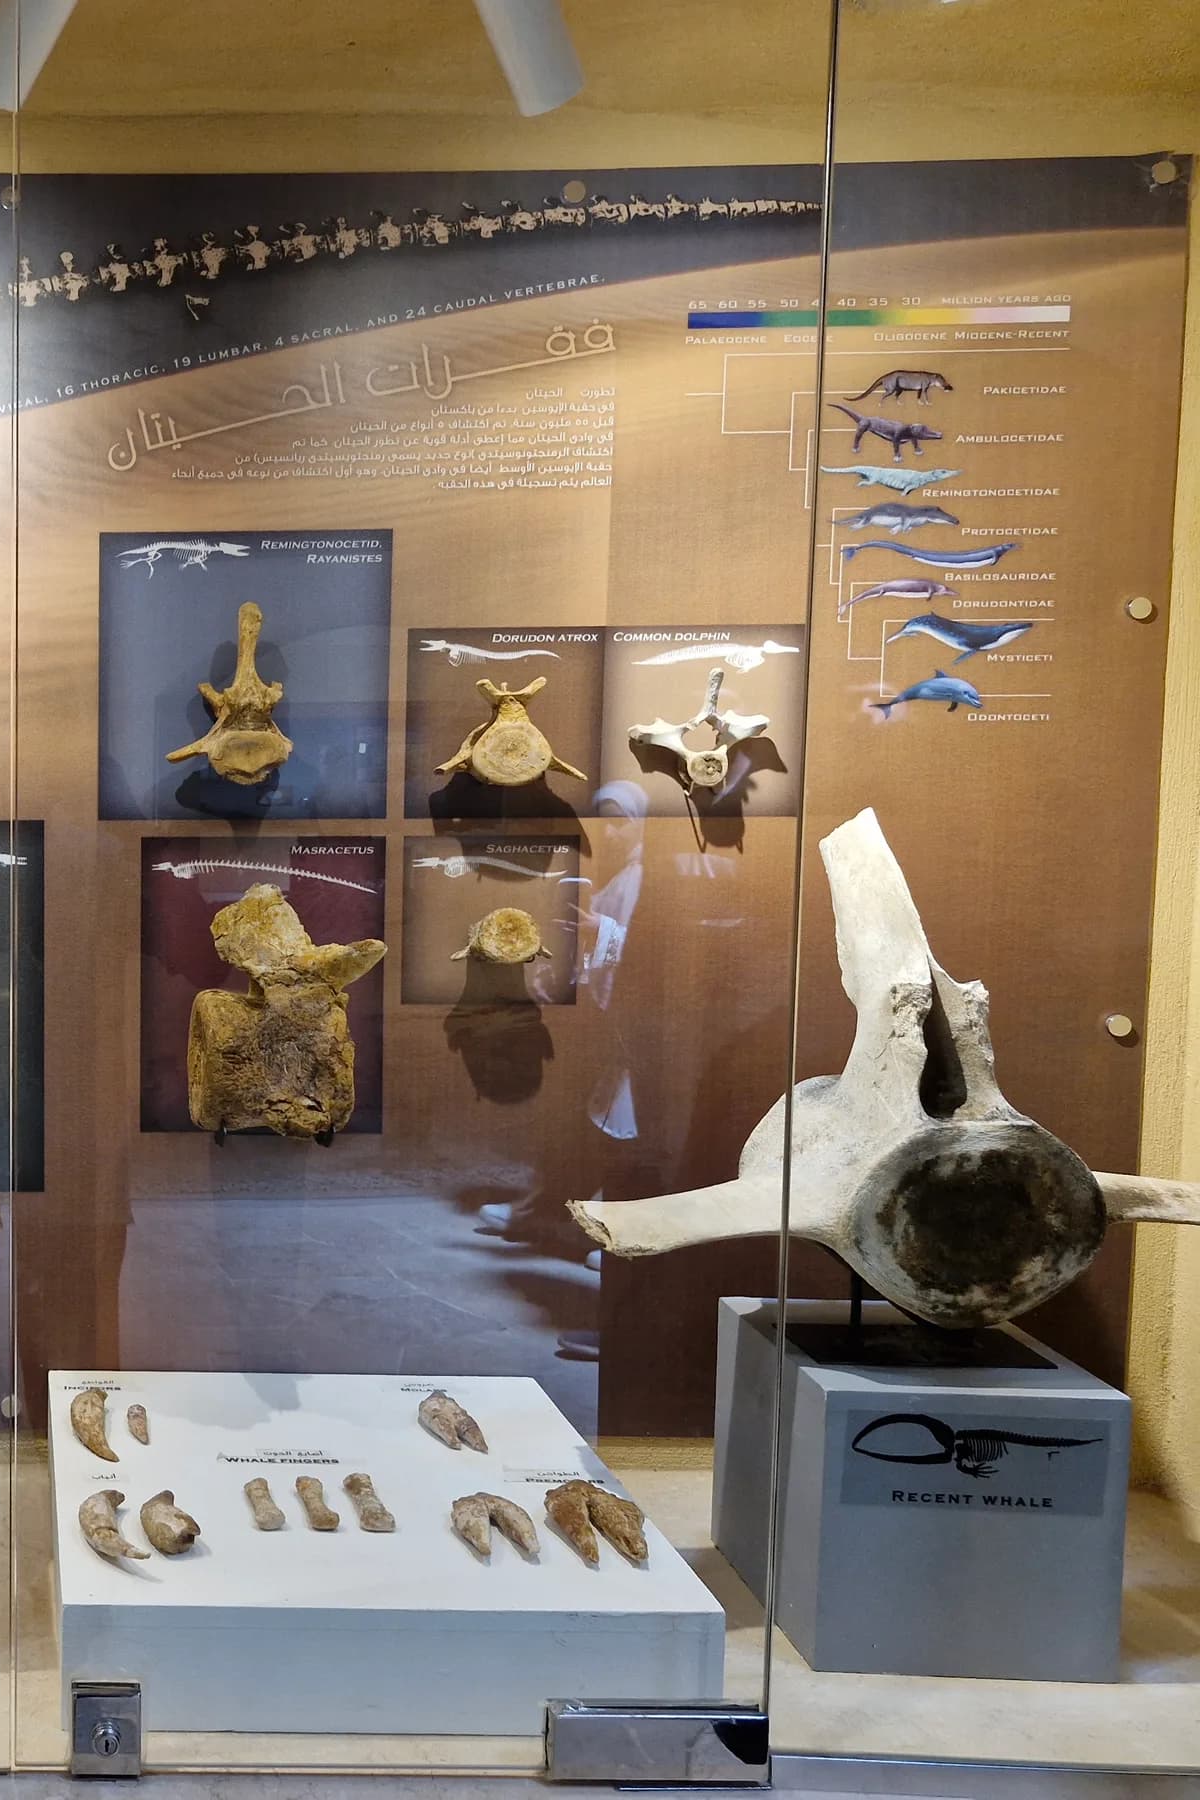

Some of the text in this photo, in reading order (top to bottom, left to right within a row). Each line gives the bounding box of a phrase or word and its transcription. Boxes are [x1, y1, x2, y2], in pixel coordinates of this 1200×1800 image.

[688, 299, 708, 311] 65
[718, 299, 738, 310] 60
[747, 299, 767, 310] 55
[780, 298, 800, 309] 50
[837, 297, 857, 308] 40
[868, 296, 888, 307] 35
[901, 296, 921, 307] 30
[942, 296, 993, 305] MILLION
[997, 295, 1039, 305] YEARS
[1043, 294, 1071, 304] AGO
[685, 329, 1070, 346] PALAEOCENE EOCEE OLIGOCENE MIOCENE-RECENT
[56, 385, 74, 398] 16
[174, 356, 192, 369] 19
[275, 336, 284, 347] 4
[367, 313, 399, 328] AND
[405, 306, 426, 320] 24
[433, 293, 498, 314] CAUDAL
[983, 385, 1068, 396] PAKICETIDAE
[956, 433, 1065, 443] AMBULOCETIDAE
[922, 487, 1061, 498] REMINGTONOCETIDAE
[961, 527, 1059, 537] PROTOCETIDAE
[306, 553, 383, 564] RAYANISTES
[944, 572, 1057, 582] BASILOSAURIDAE
[952, 599, 1056, 609] DORUDONTIDAE
[492, 631, 599, 643] DORUDON ATROX
[612, 631, 731, 642] COMMON DOLPHIN
[987, 653, 1054, 663] MYSTICETI
[967, 712, 1051, 723] ODONTOCETI
[290, 845, 376, 856] MASRACETUS
[485, 844, 570, 855] SAGHACETUS
[226, 1457, 279, 1465] WHALE
[892, 1490, 1054, 1507] RECENT WHALE
